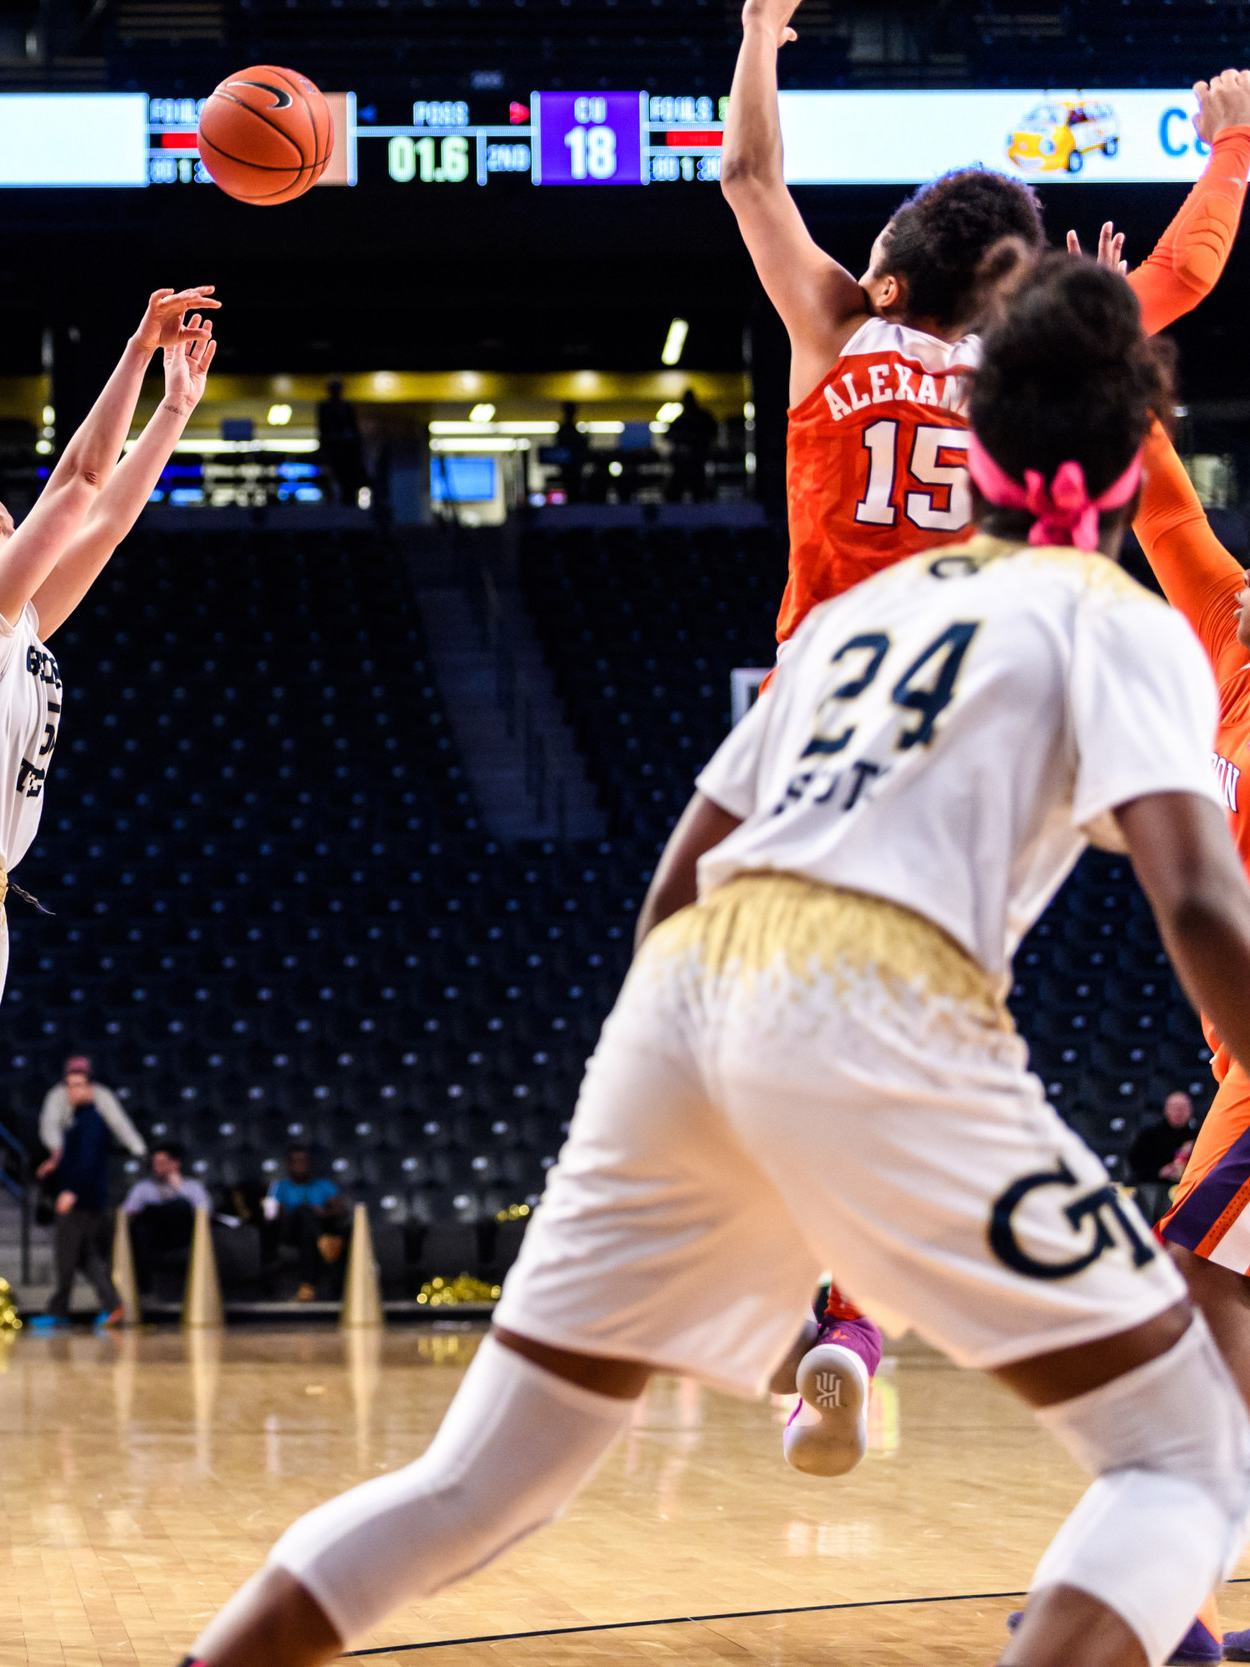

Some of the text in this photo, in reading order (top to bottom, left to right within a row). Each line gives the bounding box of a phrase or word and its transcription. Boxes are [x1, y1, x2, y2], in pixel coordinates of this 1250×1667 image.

[388, 135, 469, 183] 01.6
[564, 125, 617, 180] 18
[822, 362, 970, 422] ALEXAN
[853, 417, 972, 533] 15
[798, 618, 984, 761] 24
